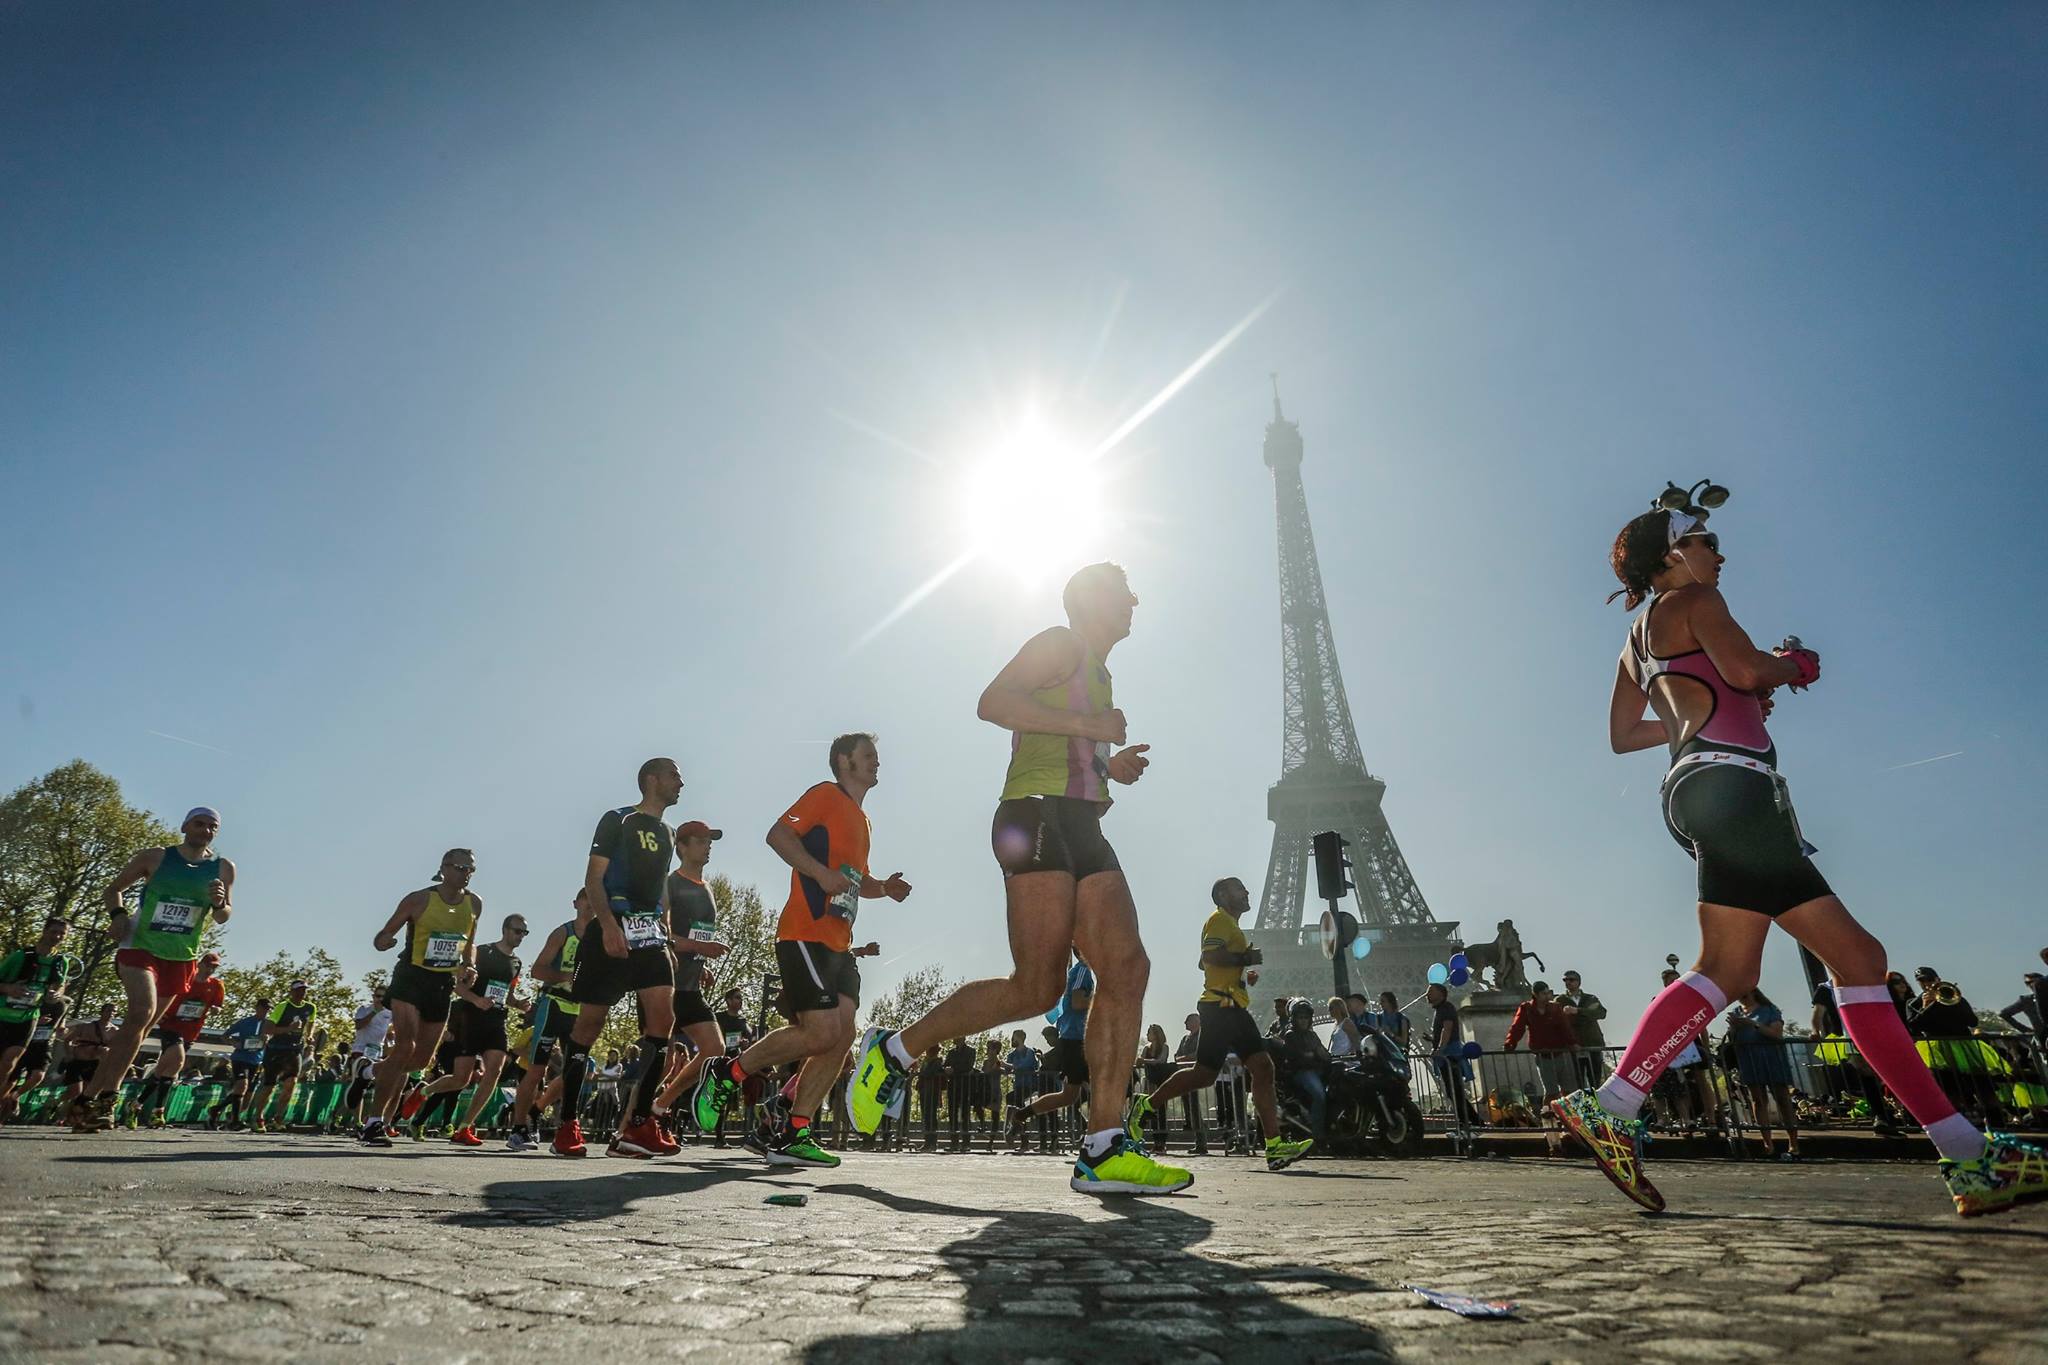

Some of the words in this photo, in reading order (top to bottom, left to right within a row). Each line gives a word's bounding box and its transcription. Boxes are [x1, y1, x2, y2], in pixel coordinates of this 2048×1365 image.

[636, 830, 659, 852] 16
[162, 904, 190, 917] 12179
[433, 940, 458, 952] 10755
[1642, 1009, 1706, 1070] COMPRESSPORT
